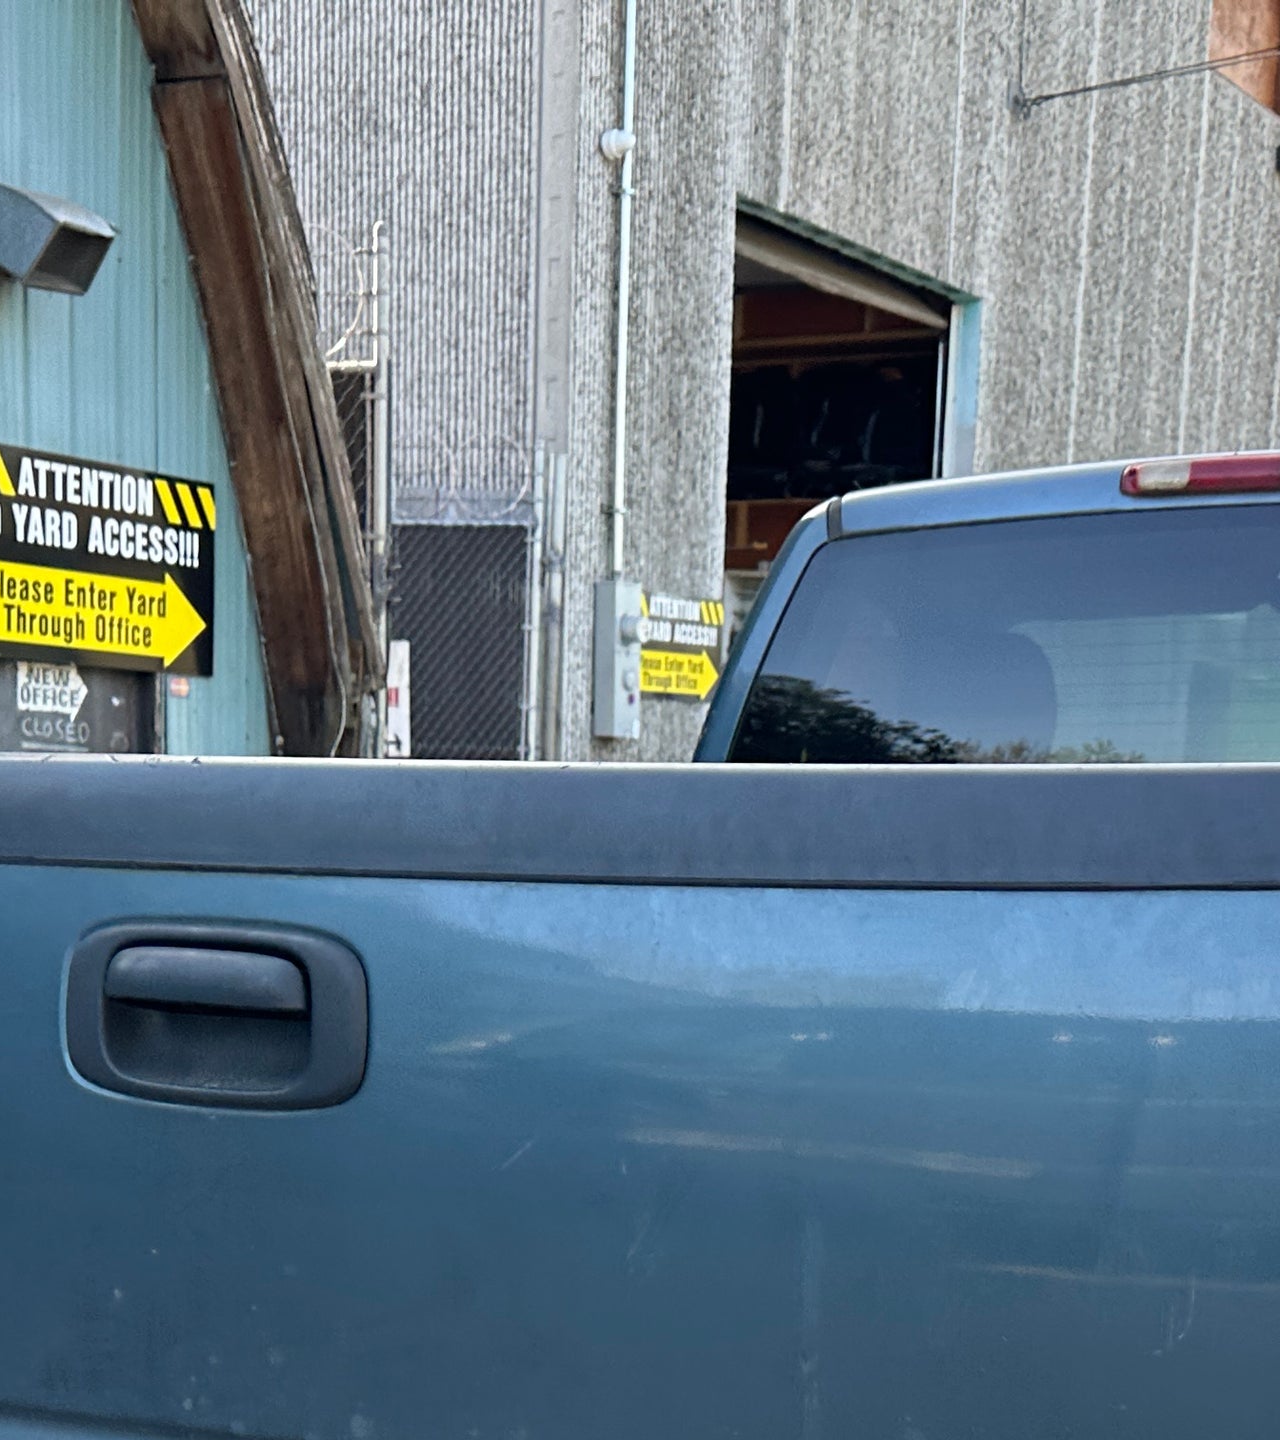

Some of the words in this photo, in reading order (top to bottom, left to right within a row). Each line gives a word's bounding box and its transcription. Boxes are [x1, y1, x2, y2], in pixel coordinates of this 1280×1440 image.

[18, 456, 154, 517] ATTENTION
[12, 503, 78, 550] YARD
[87, 515, 199, 568] ACCESS!!!
[64, 578, 117, 613] Enter
[126, 586, 167, 618] Yard
[4, 604, 86, 643] Through
[95, 614, 152, 648] Office
[21, 684, 80, 707] OFFICE
[25, 664, 70, 687] NEW
